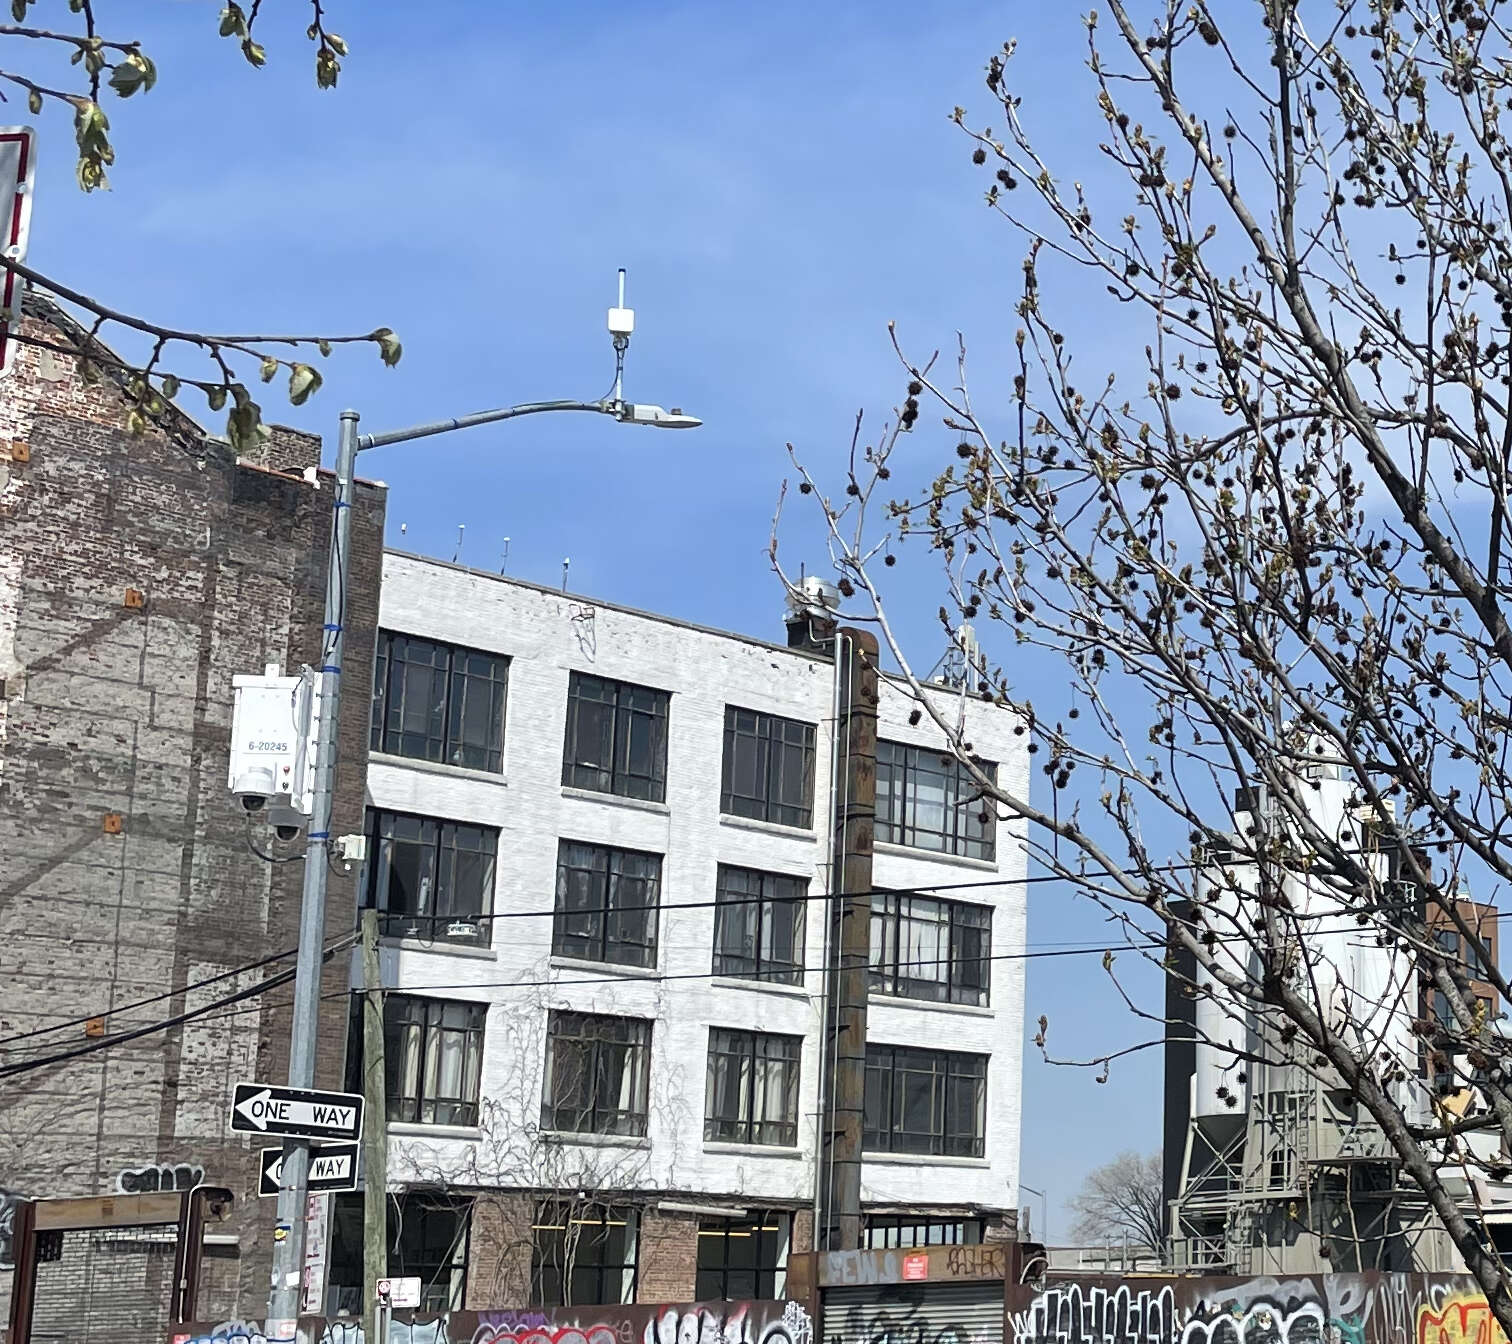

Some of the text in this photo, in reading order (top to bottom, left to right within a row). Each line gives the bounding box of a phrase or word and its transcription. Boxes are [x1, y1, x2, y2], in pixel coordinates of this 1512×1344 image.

[248, 741, 288, 752] 6-20245
[251, 1100, 351, 1126] ONE WAY
[315, 1159, 345, 1177] WAY
